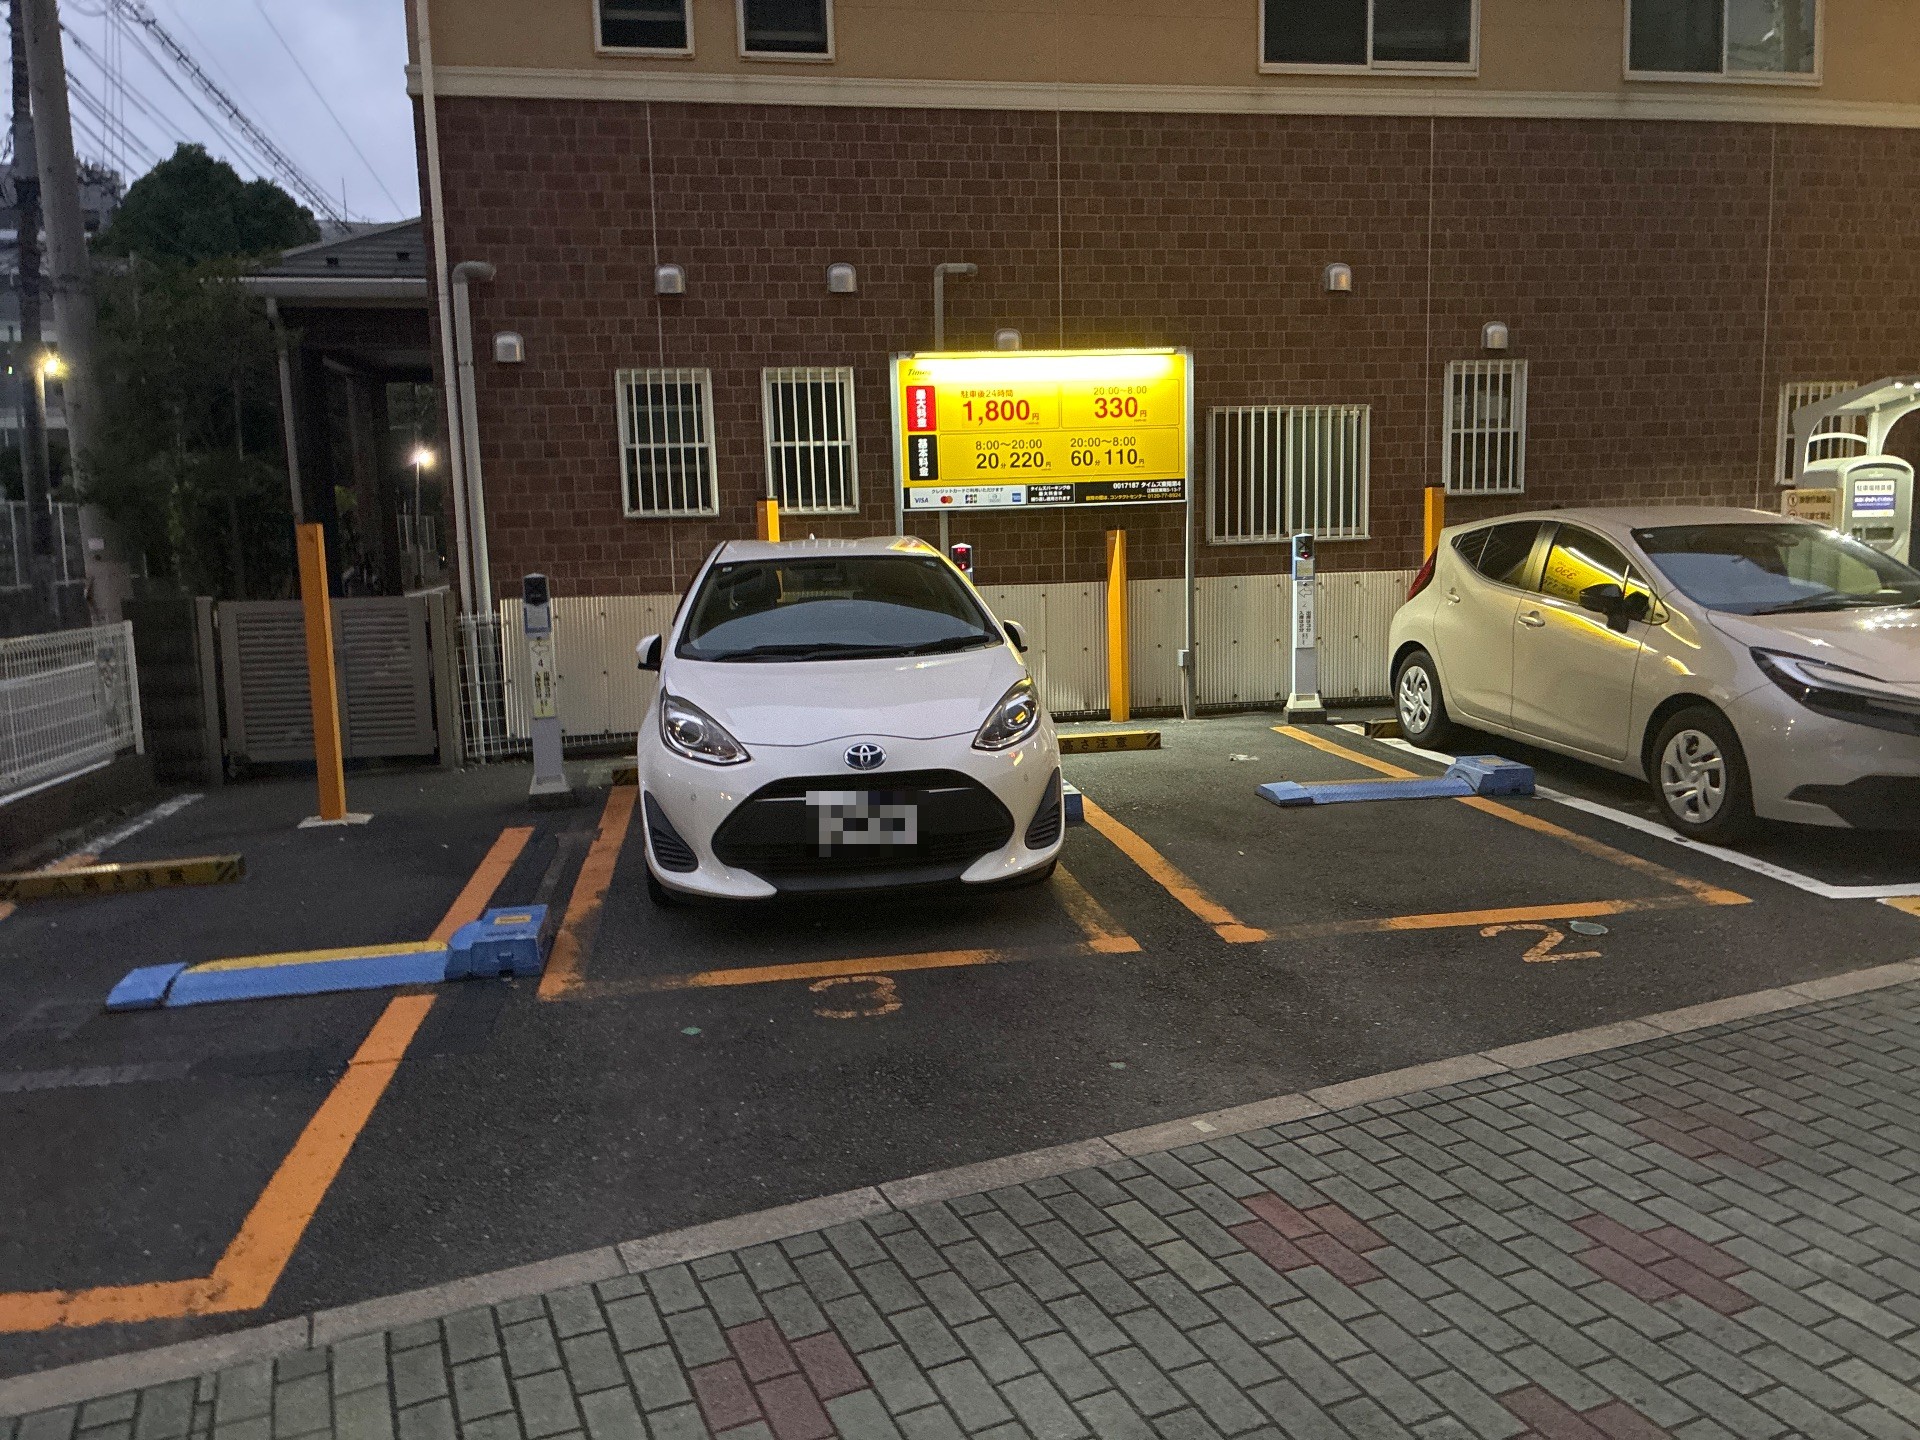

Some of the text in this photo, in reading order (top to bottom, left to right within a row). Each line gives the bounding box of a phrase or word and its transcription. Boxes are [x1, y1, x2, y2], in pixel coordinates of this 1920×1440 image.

[918, 438, 929, 477] 基本料金
[1062, 737, 1127, 752] 高さ注意
[1480, 922, 1601, 963] 2
[808, 975, 903, 1019] 3
